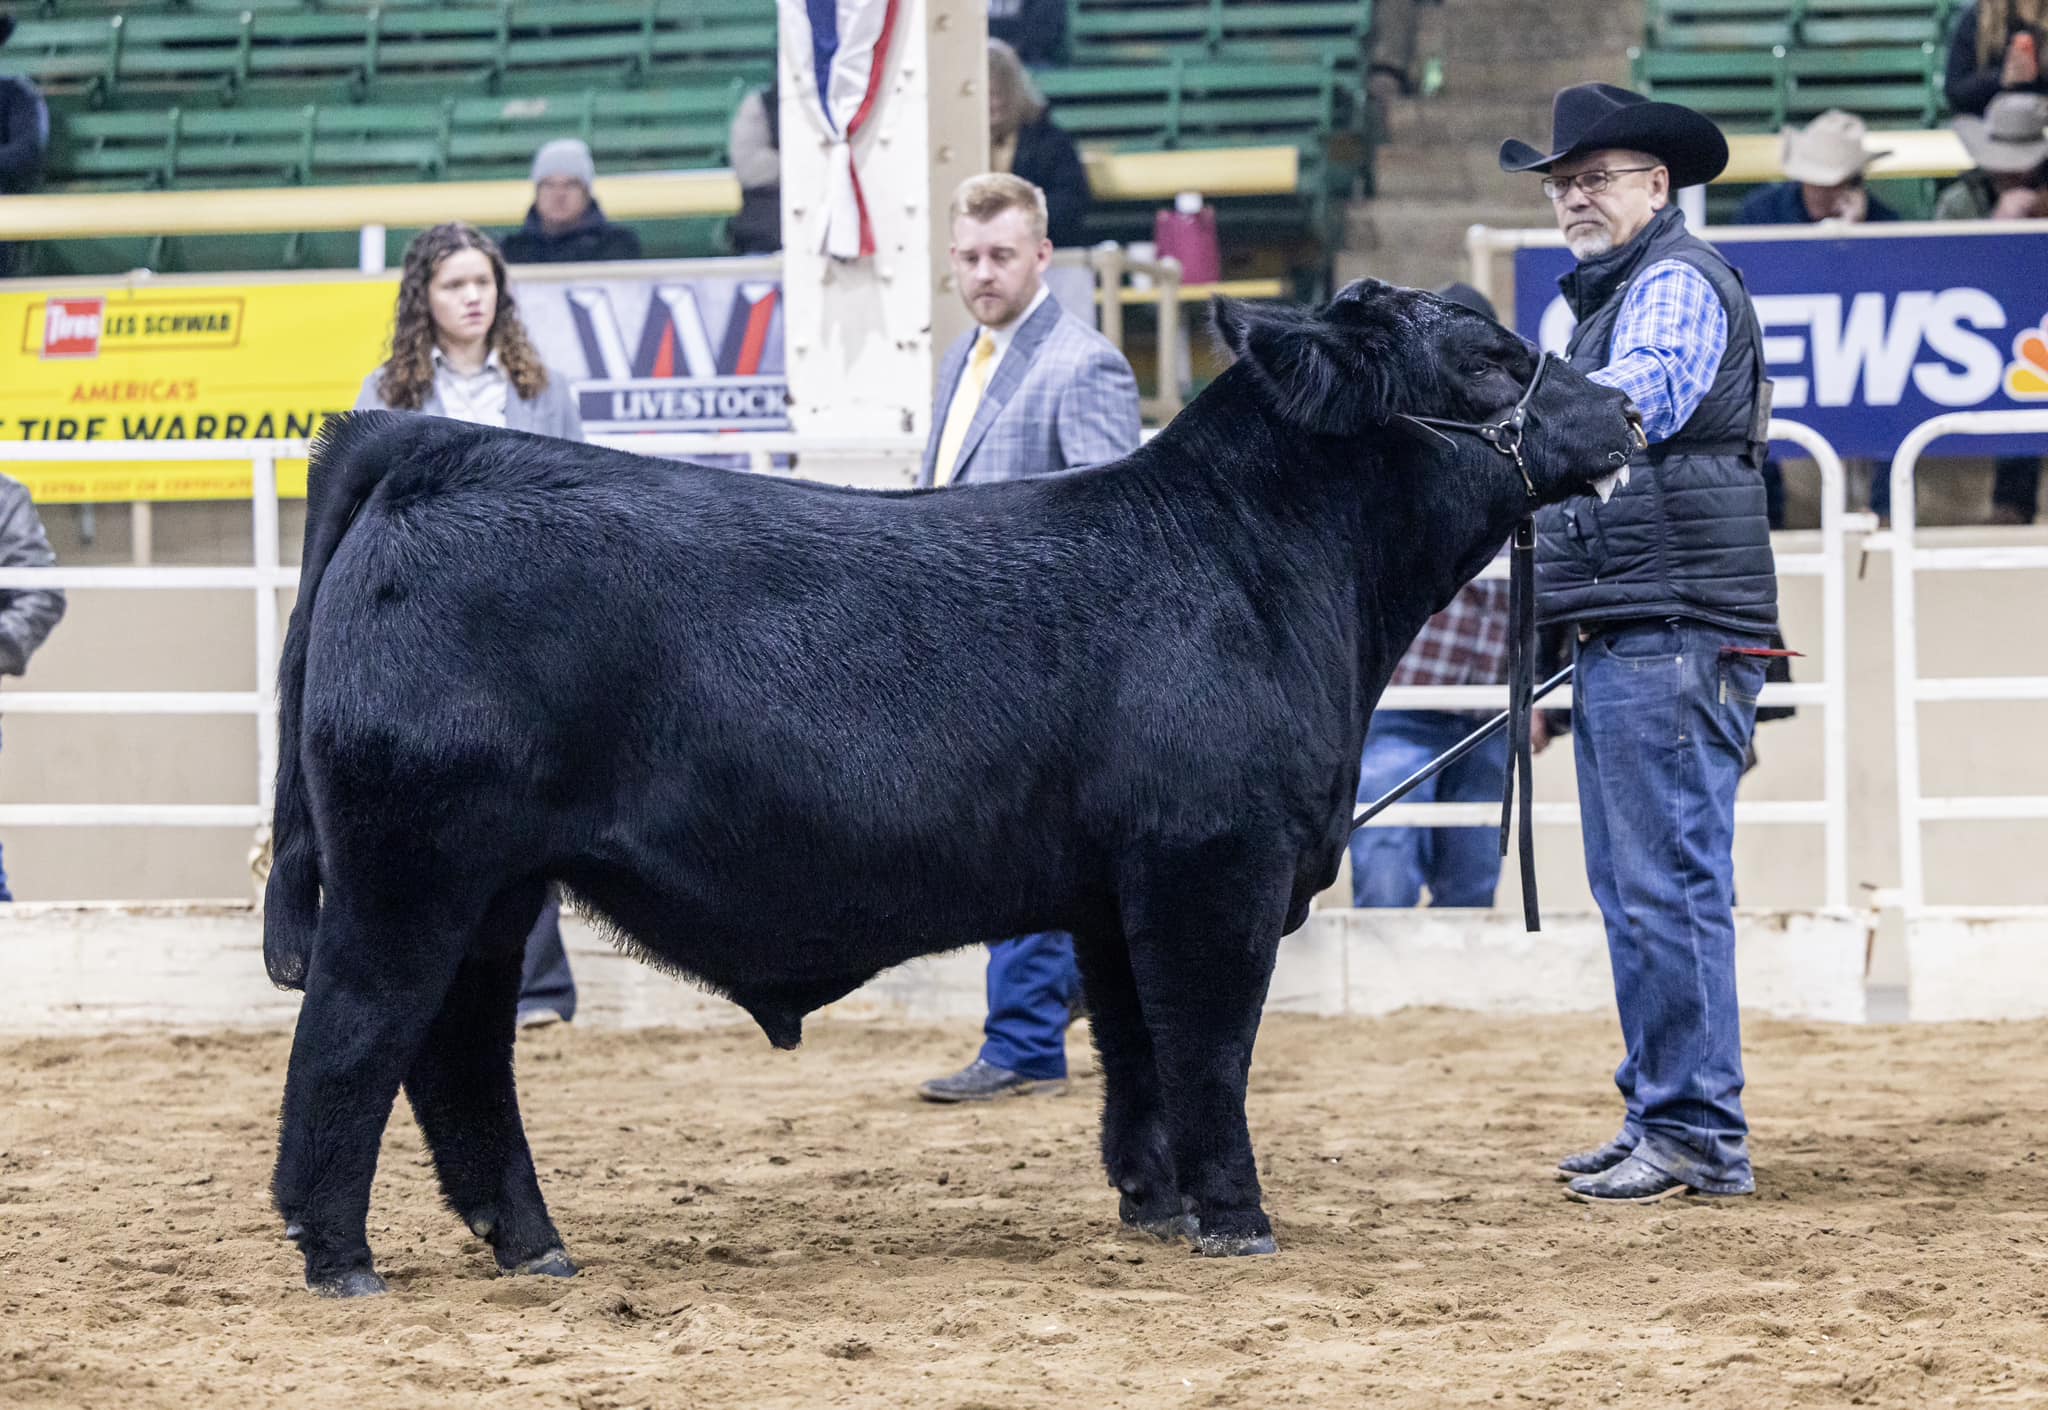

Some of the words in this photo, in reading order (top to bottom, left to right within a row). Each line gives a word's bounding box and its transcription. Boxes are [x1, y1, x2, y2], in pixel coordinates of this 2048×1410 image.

[105, 315, 137, 336] LES
[144, 313, 231, 335] SCHWAB
[71, 379, 199, 403] AMERICA'S
[612, 388, 787, 420] LIVESTOCK
